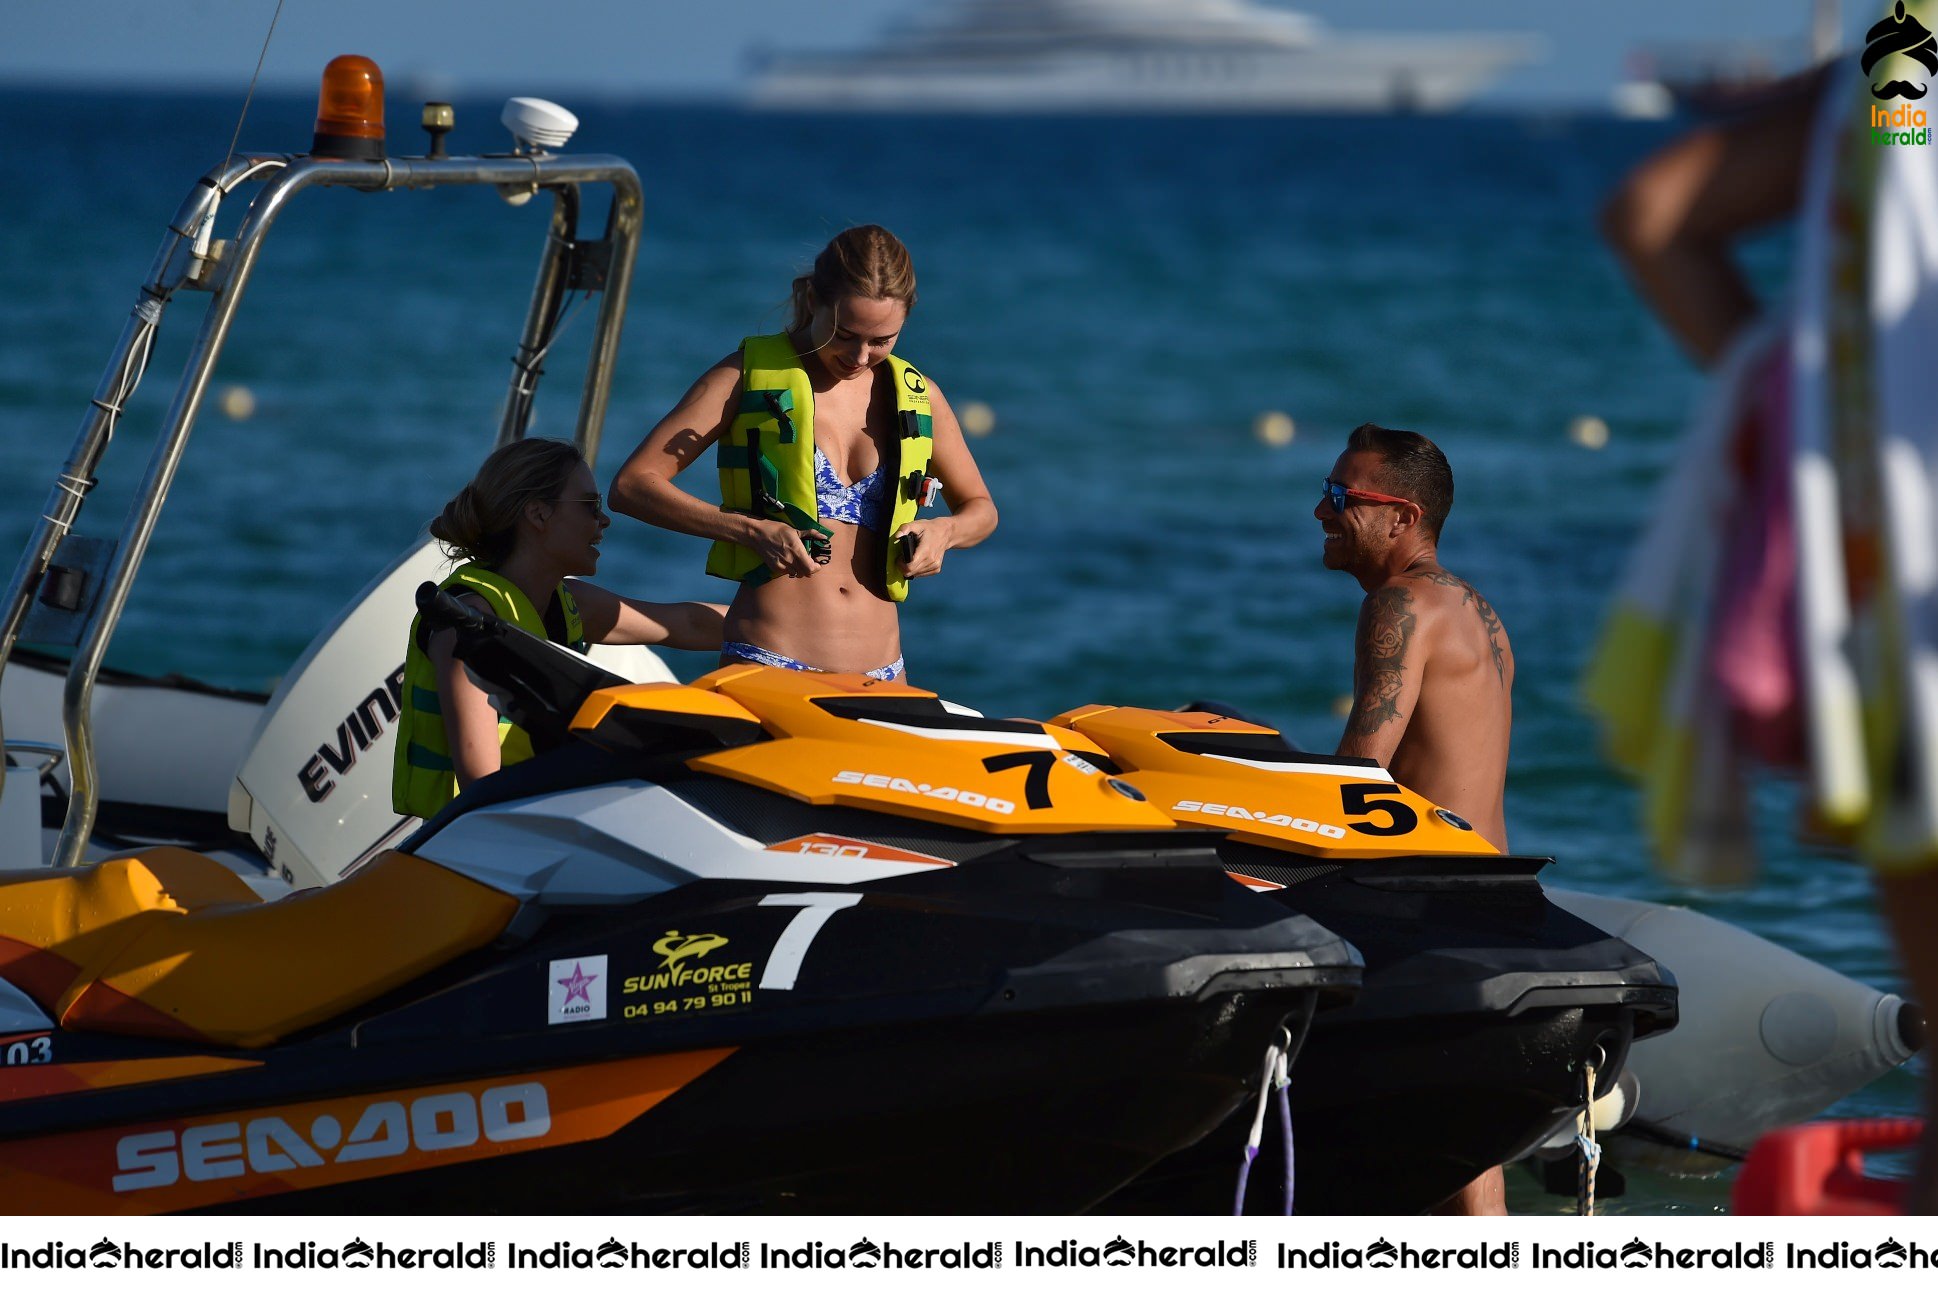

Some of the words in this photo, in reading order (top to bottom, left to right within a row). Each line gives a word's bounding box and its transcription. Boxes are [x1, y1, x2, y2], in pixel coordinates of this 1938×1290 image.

[981, 751, 1057, 811] 7
[1339, 782, 1418, 837] 5
[798, 841, 869, 858] 130
[757, 892, 864, 991] 7
[623, 974, 673, 994] SUN
[679, 962, 752, 987] FORCE
[623, 1003, 648, 1019] 04
[653, 1000, 678, 1015] 94
[682, 997, 706, 1010] 79
[711, 992, 736, 1007] 90
[741, 990, 752, 1004] 11
[0, 1036, 53, 1065] 03
